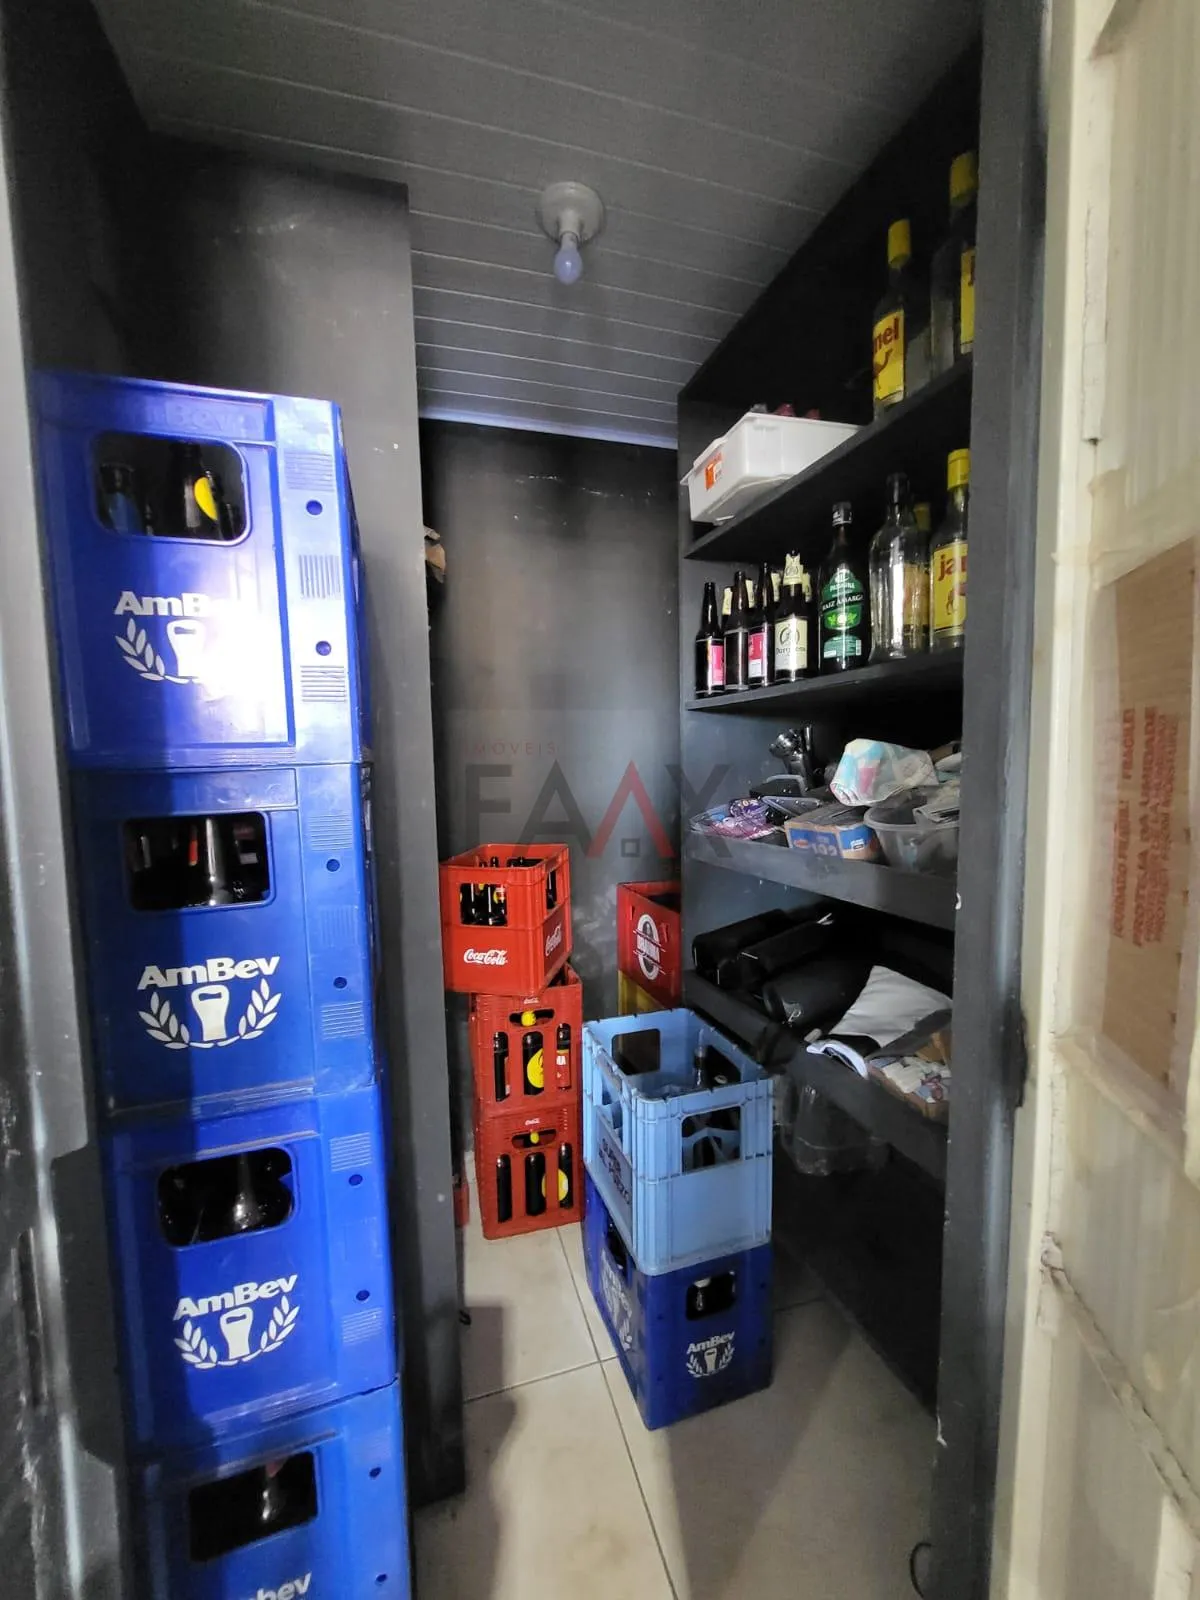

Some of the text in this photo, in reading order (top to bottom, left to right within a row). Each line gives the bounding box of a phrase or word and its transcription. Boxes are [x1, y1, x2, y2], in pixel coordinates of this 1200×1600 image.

[114, 590, 210, 617] AmB
[137, 956, 280, 991] AmBev
[173, 1274, 298, 1321] AmBev
[686, 1330, 735, 1355] AmBev
